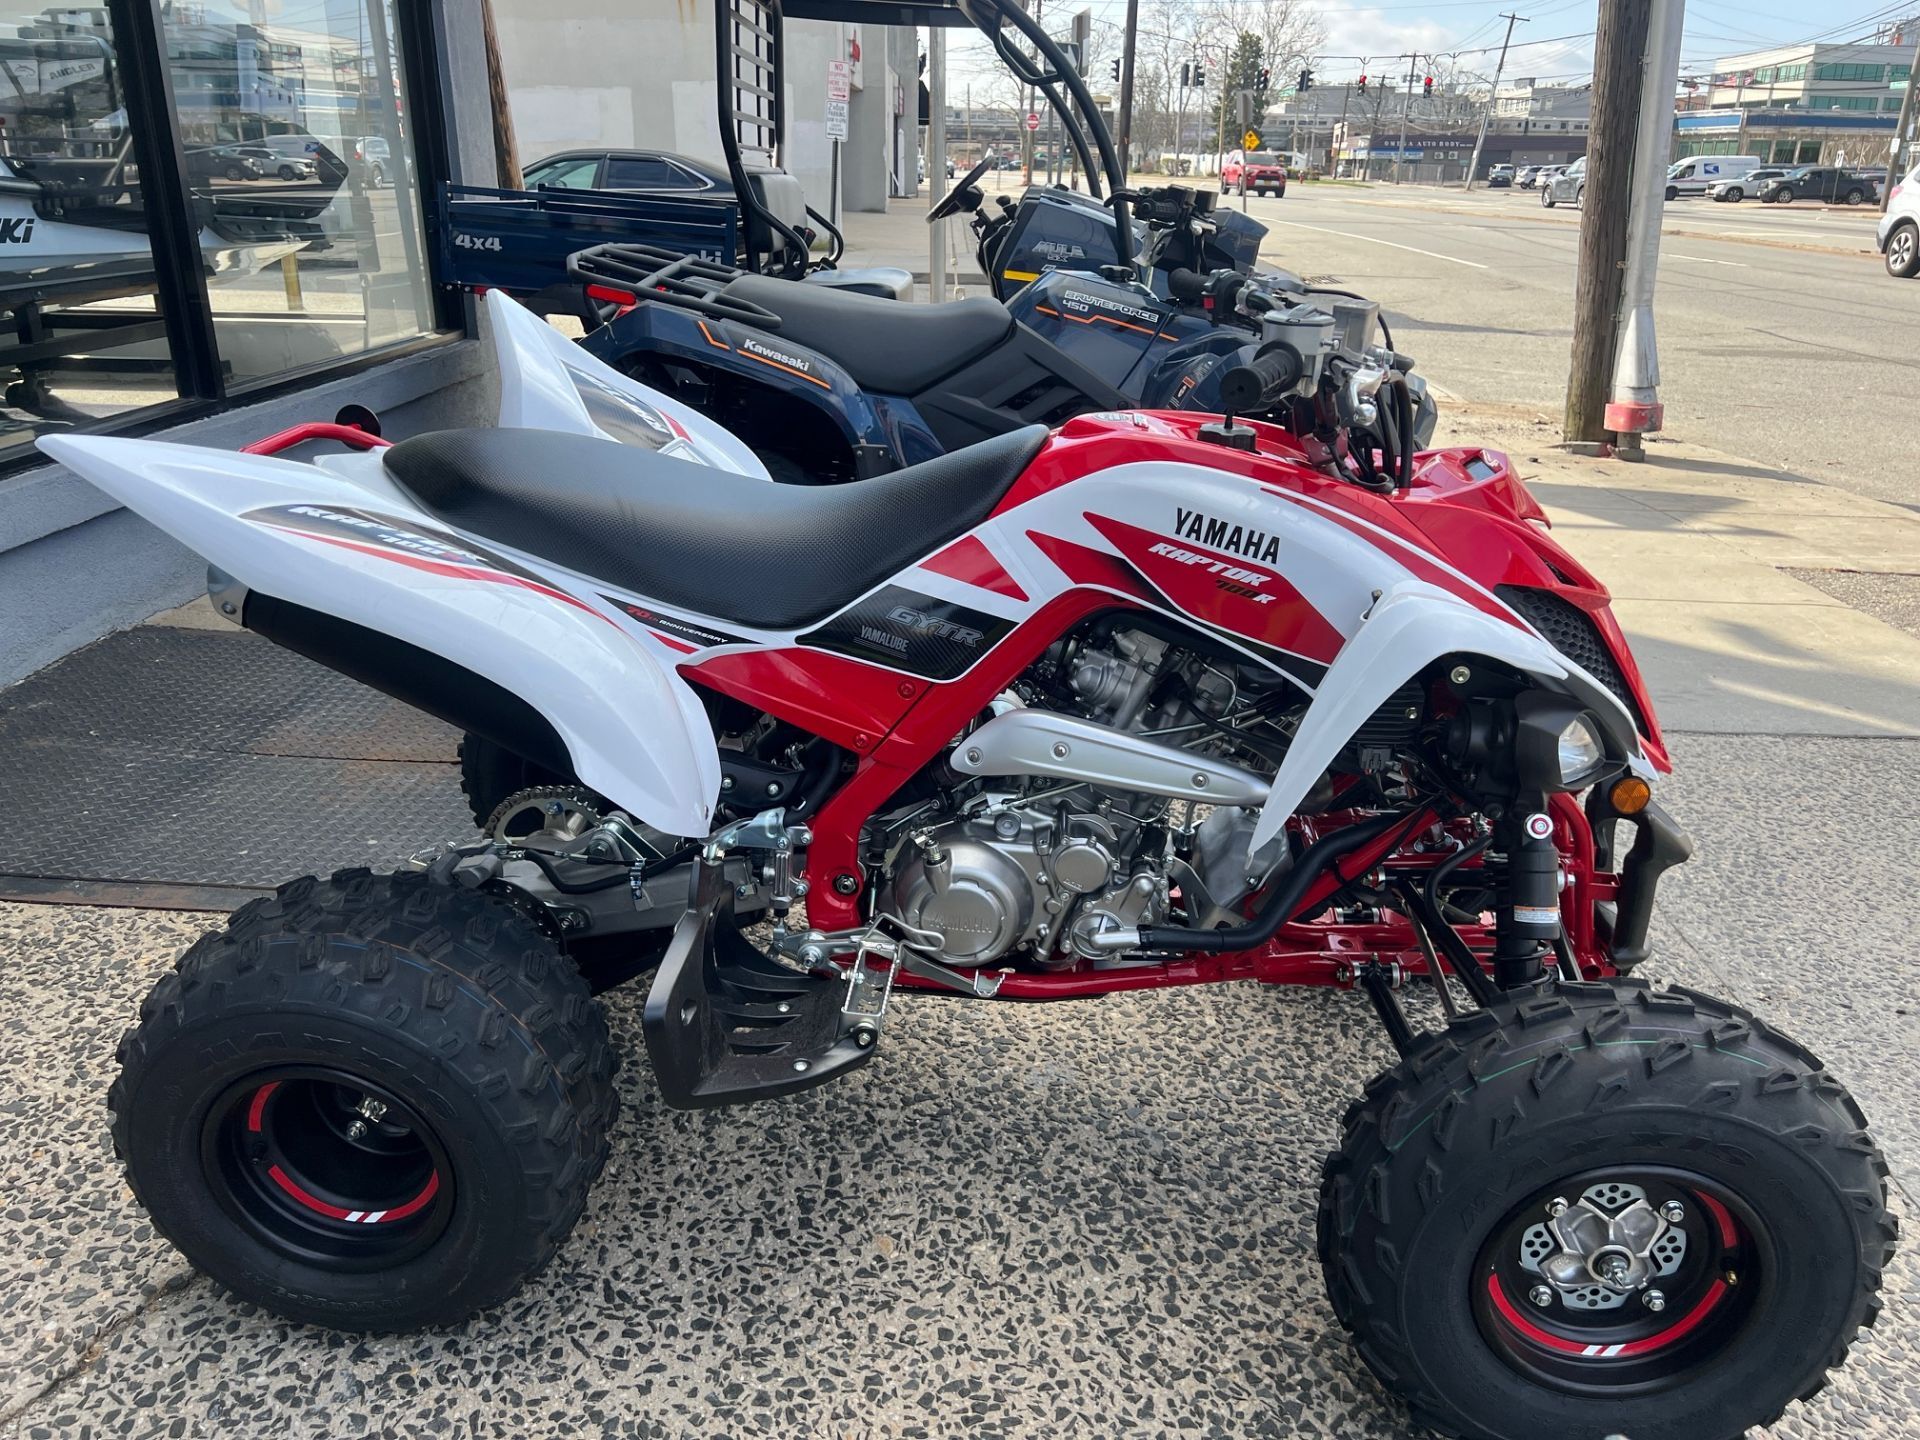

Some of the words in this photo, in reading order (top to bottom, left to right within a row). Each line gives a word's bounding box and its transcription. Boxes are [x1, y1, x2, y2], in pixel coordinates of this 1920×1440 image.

[834, 64, 844, 72] NO
[455, 234, 503, 252] 4x4
[1062, 299, 1089, 312] 450
[743, 339, 810, 371] Kawasaki
[1174, 507, 1281, 565] YAMAHA
[1148, 542, 1272, 587] RAPTOR
[1215, 579, 1277, 604] 700R
[659, 619, 728, 643] ANNIVERSARY
[860, 625, 909, 652] YAMALUBE
[885, 605, 985, 647] GYTR
